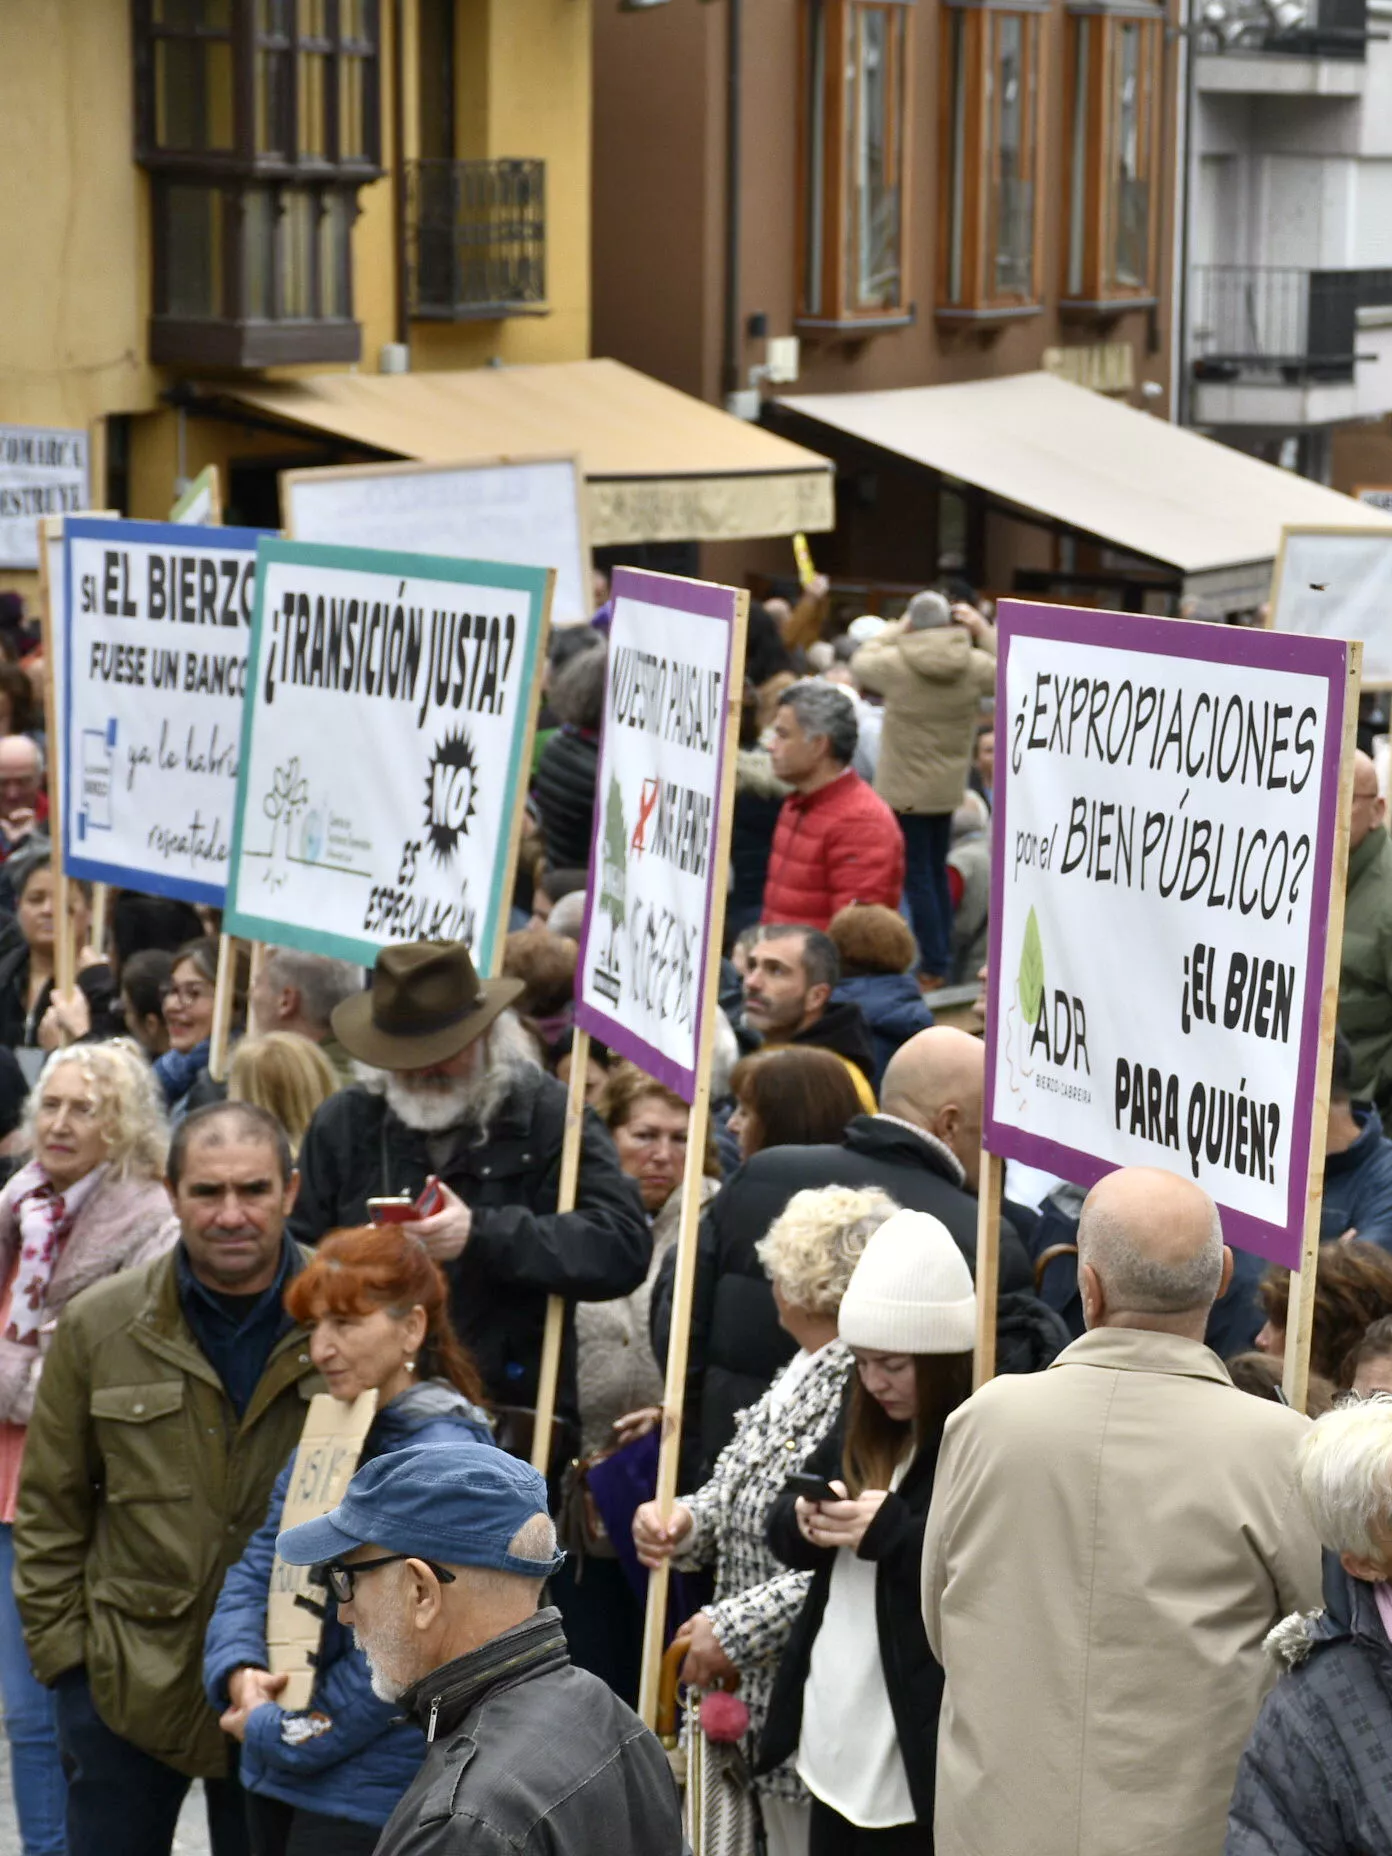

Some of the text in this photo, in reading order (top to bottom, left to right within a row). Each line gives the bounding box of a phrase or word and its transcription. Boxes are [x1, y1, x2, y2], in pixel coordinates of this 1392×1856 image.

[0, 436, 82, 468] OMARCA
[81, 573, 97, 614] SI
[104, 550, 137, 618] EL
[90, 641, 146, 687] FUESE
[151, 648, 179, 690] UN
[264, 580, 515, 729] ¿TRANSICIÓN JUSTA?
[1012, 671, 1318, 795] ¿EXPROPIACIONES
[433, 763, 471, 830] NO
[397, 840, 422, 877] ES
[1014, 787, 1311, 925] por el BIEN PÚBLICO?
[1030, 984, 1091, 1076] ADR
[1181, 942, 1296, 1044] ¡EL BIEN
[1115, 1056, 1281, 1186] PARA QUIÉN?
